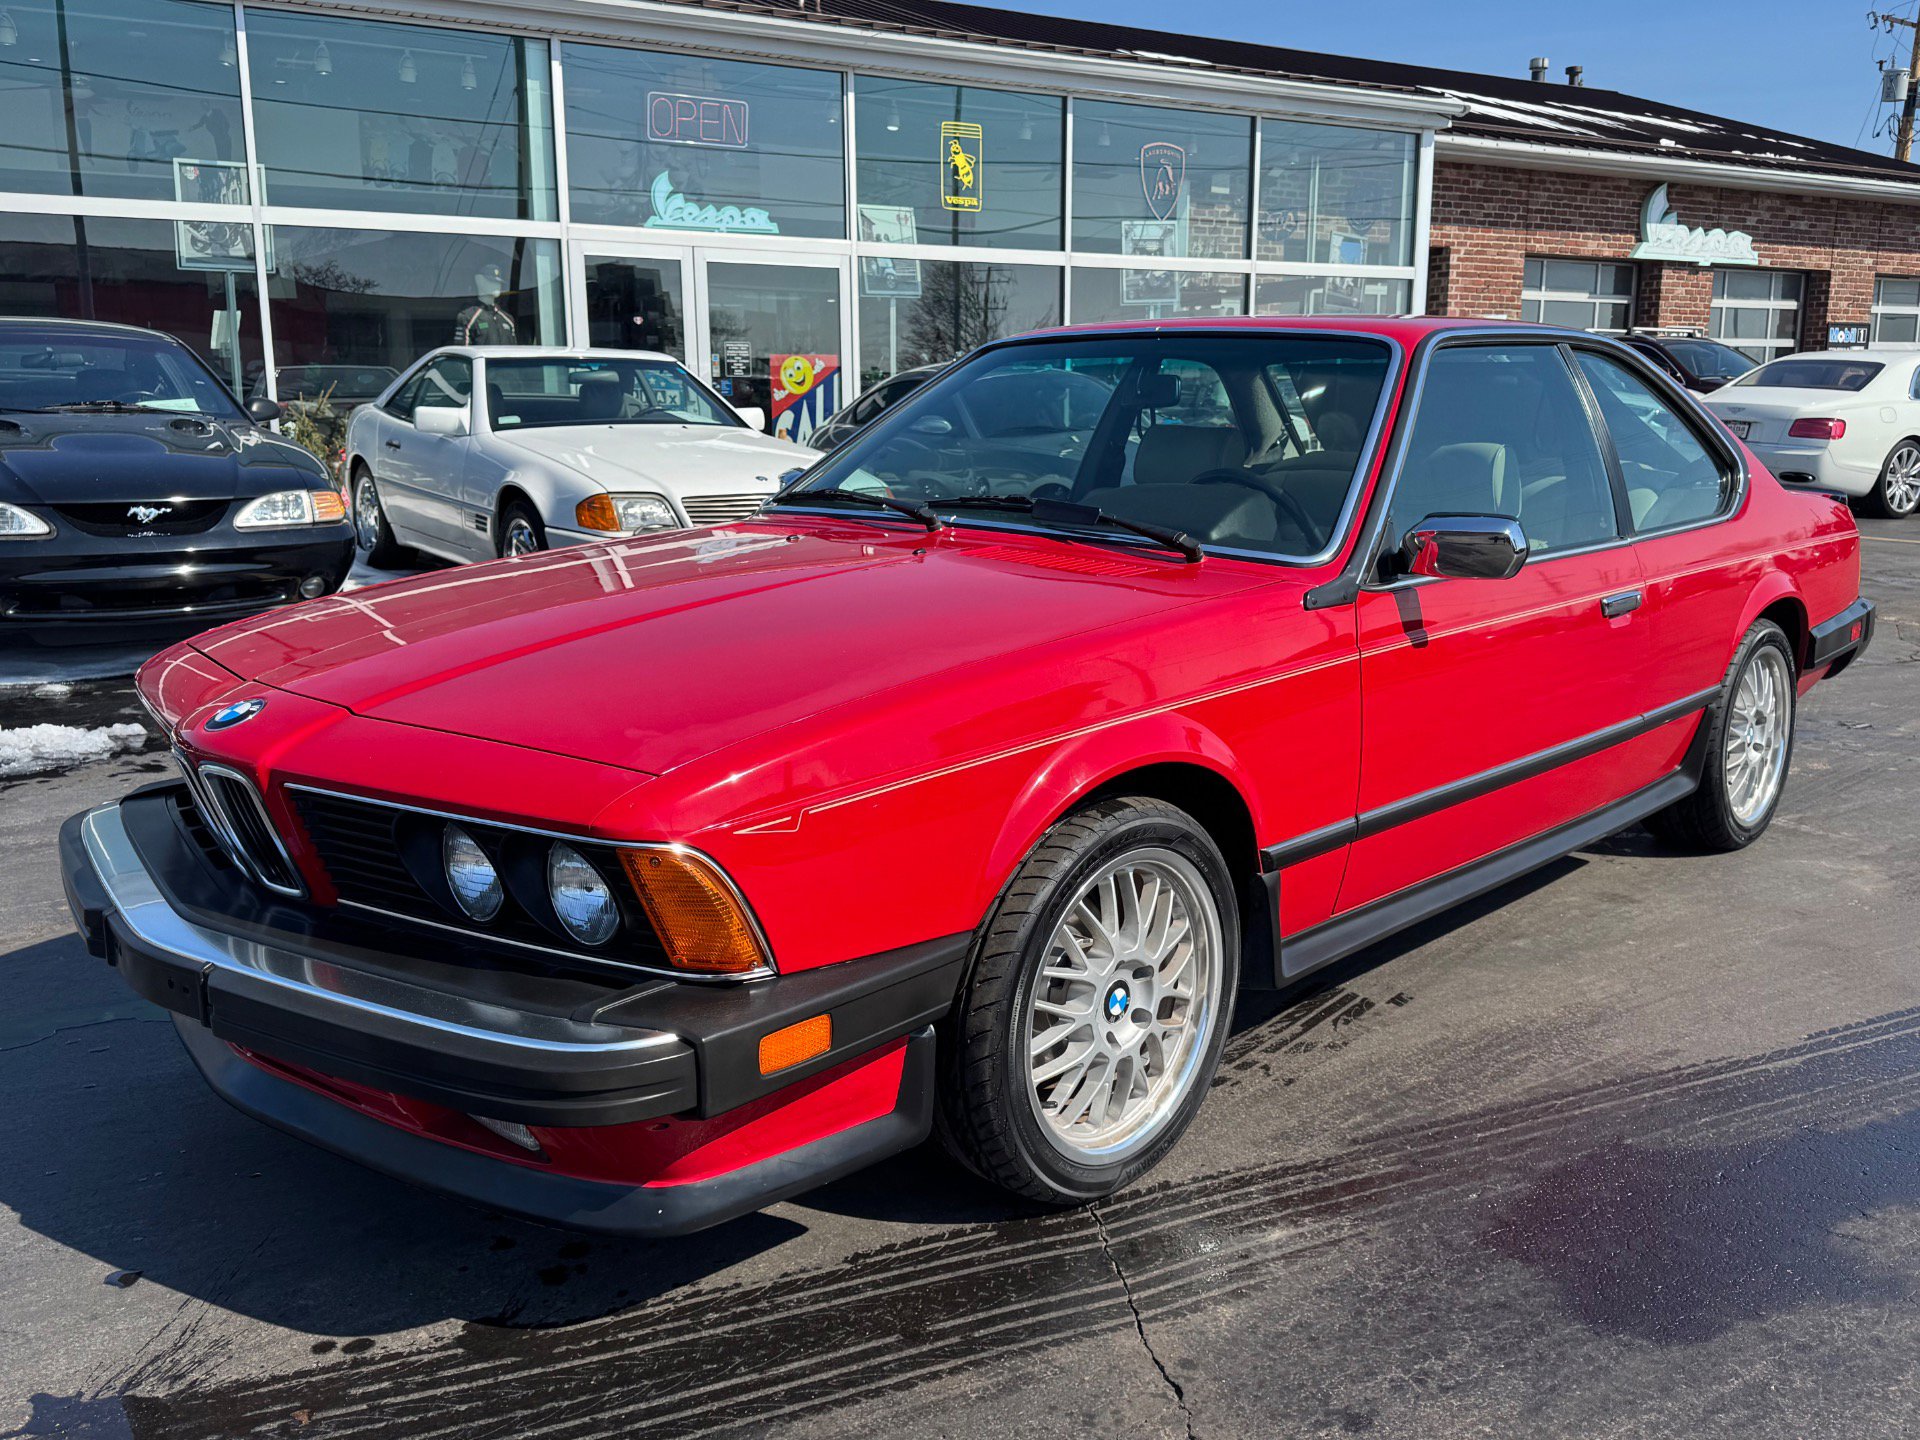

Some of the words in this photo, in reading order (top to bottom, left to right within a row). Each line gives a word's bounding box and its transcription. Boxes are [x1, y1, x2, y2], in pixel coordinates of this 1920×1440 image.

[652, 97, 744, 144] OPEN
[648, 170, 778, 232] Vespa
[945, 195, 978, 207] Vespa
[1634, 182, 1758, 265] Vespa
[1828, 327, 1857, 343] Mobil
